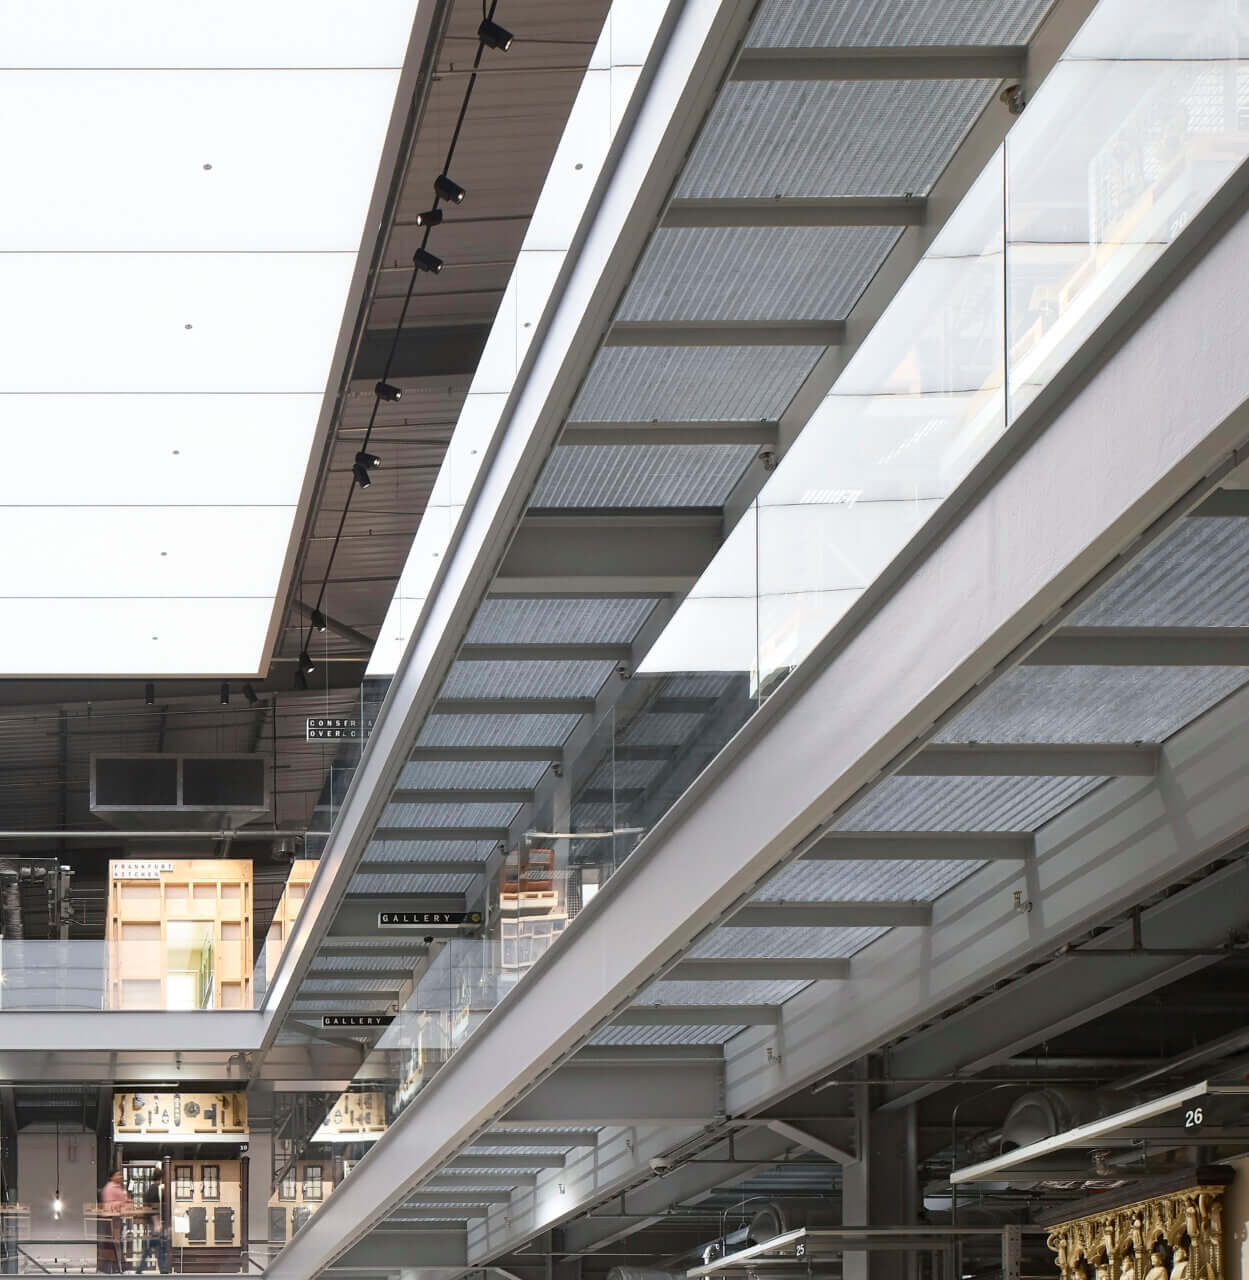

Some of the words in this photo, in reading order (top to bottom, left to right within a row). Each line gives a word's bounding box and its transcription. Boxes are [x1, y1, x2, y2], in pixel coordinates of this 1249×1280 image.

[382, 914, 451, 922] GALLERY
[324, 1017, 382, 1025] GALLERY
[1185, 1107, 1204, 1128] 26
[796, 1244, 805, 1256] 25
